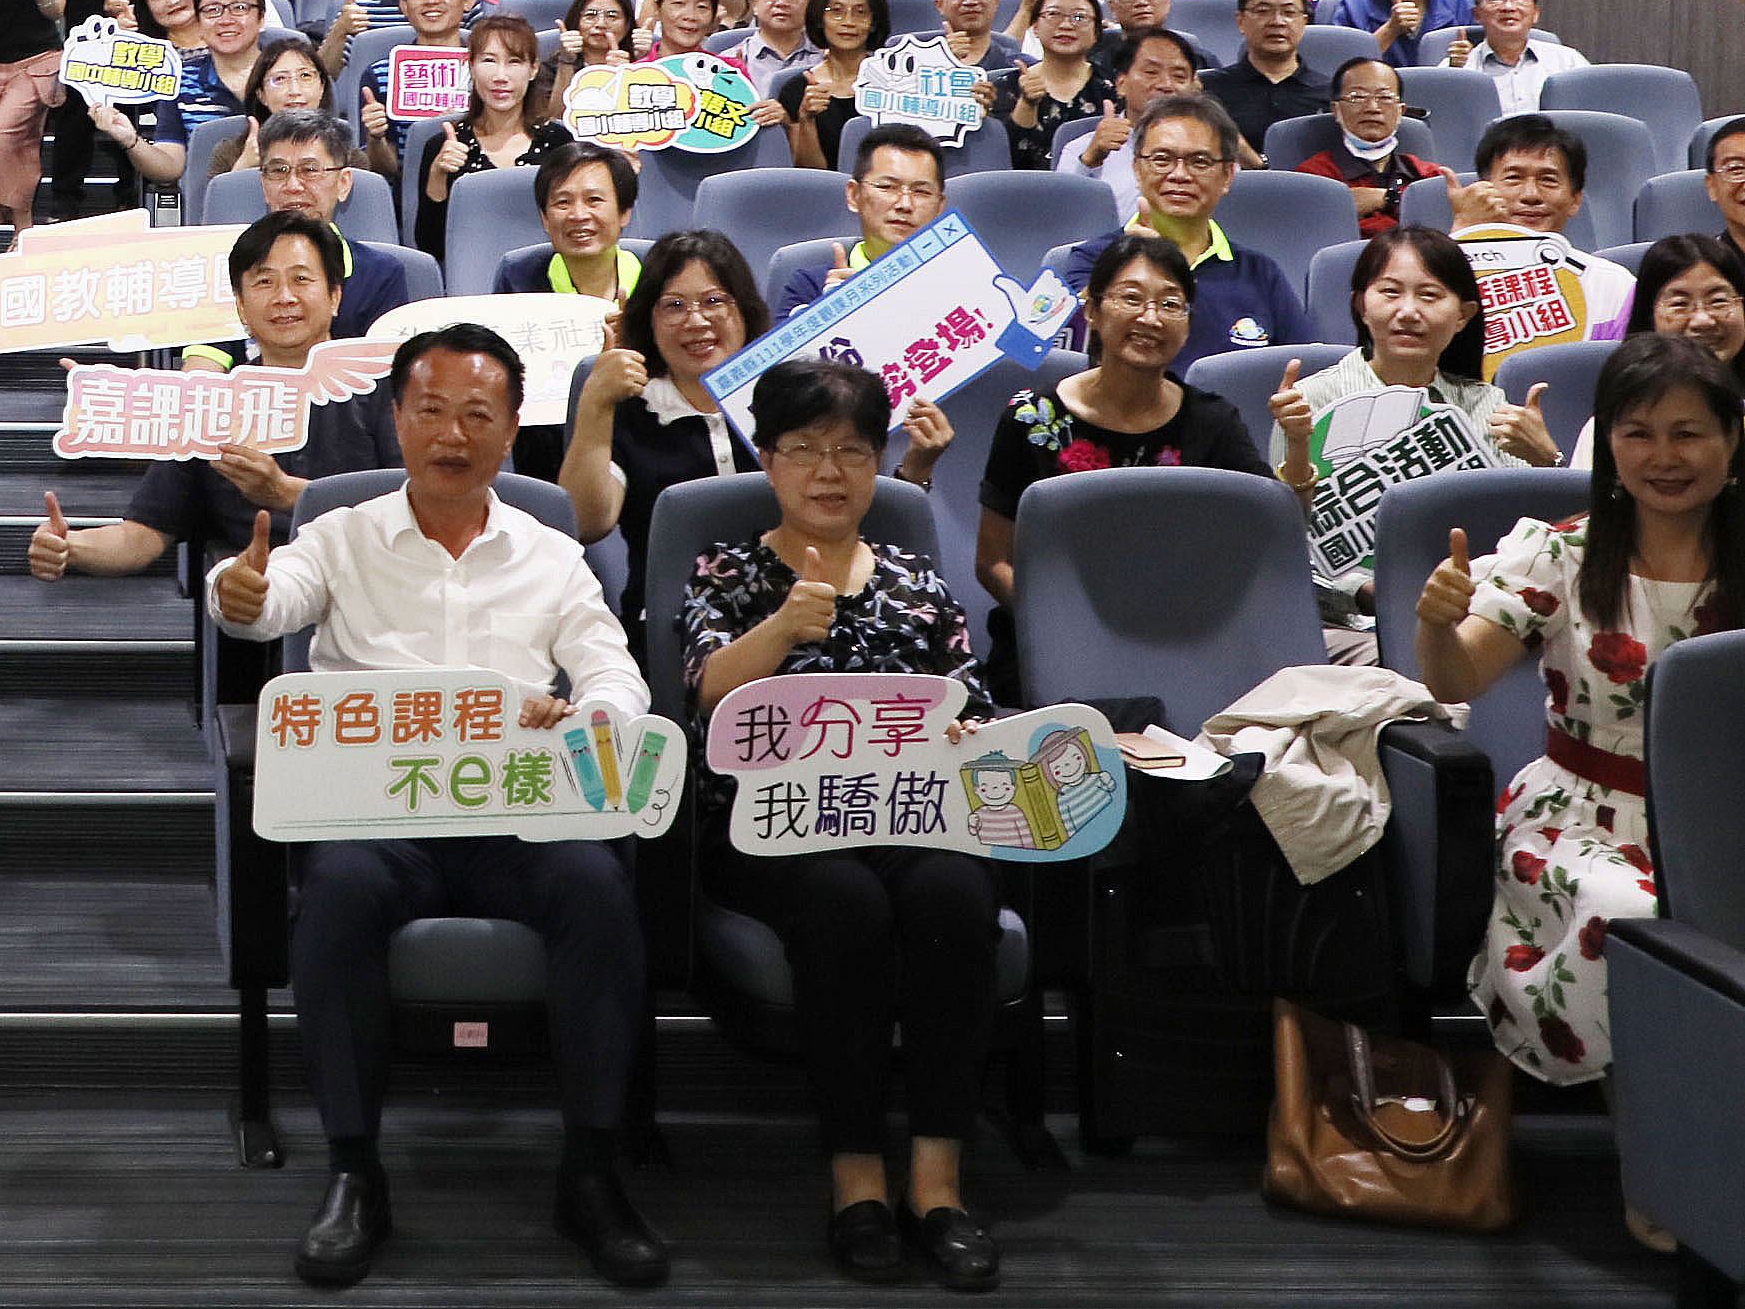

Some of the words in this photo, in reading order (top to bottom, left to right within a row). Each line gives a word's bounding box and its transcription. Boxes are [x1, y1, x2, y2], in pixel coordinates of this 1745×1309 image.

[65, 61, 176, 96] 國中輔導小組
[112, 41, 166, 69] 數學
[403, 63, 456, 89] 藝術
[863, 90, 976, 122] 國小輔導小組
[920, 70, 976, 98] 社會
[68, 379, 299, 447] 嘉課起飛
[271, 688, 504, 747] 特色課程
[734, 693, 931, 762] 我分享
[388, 751, 554, 811] 不e樣
[753, 770, 950, 840] 我驕傲
